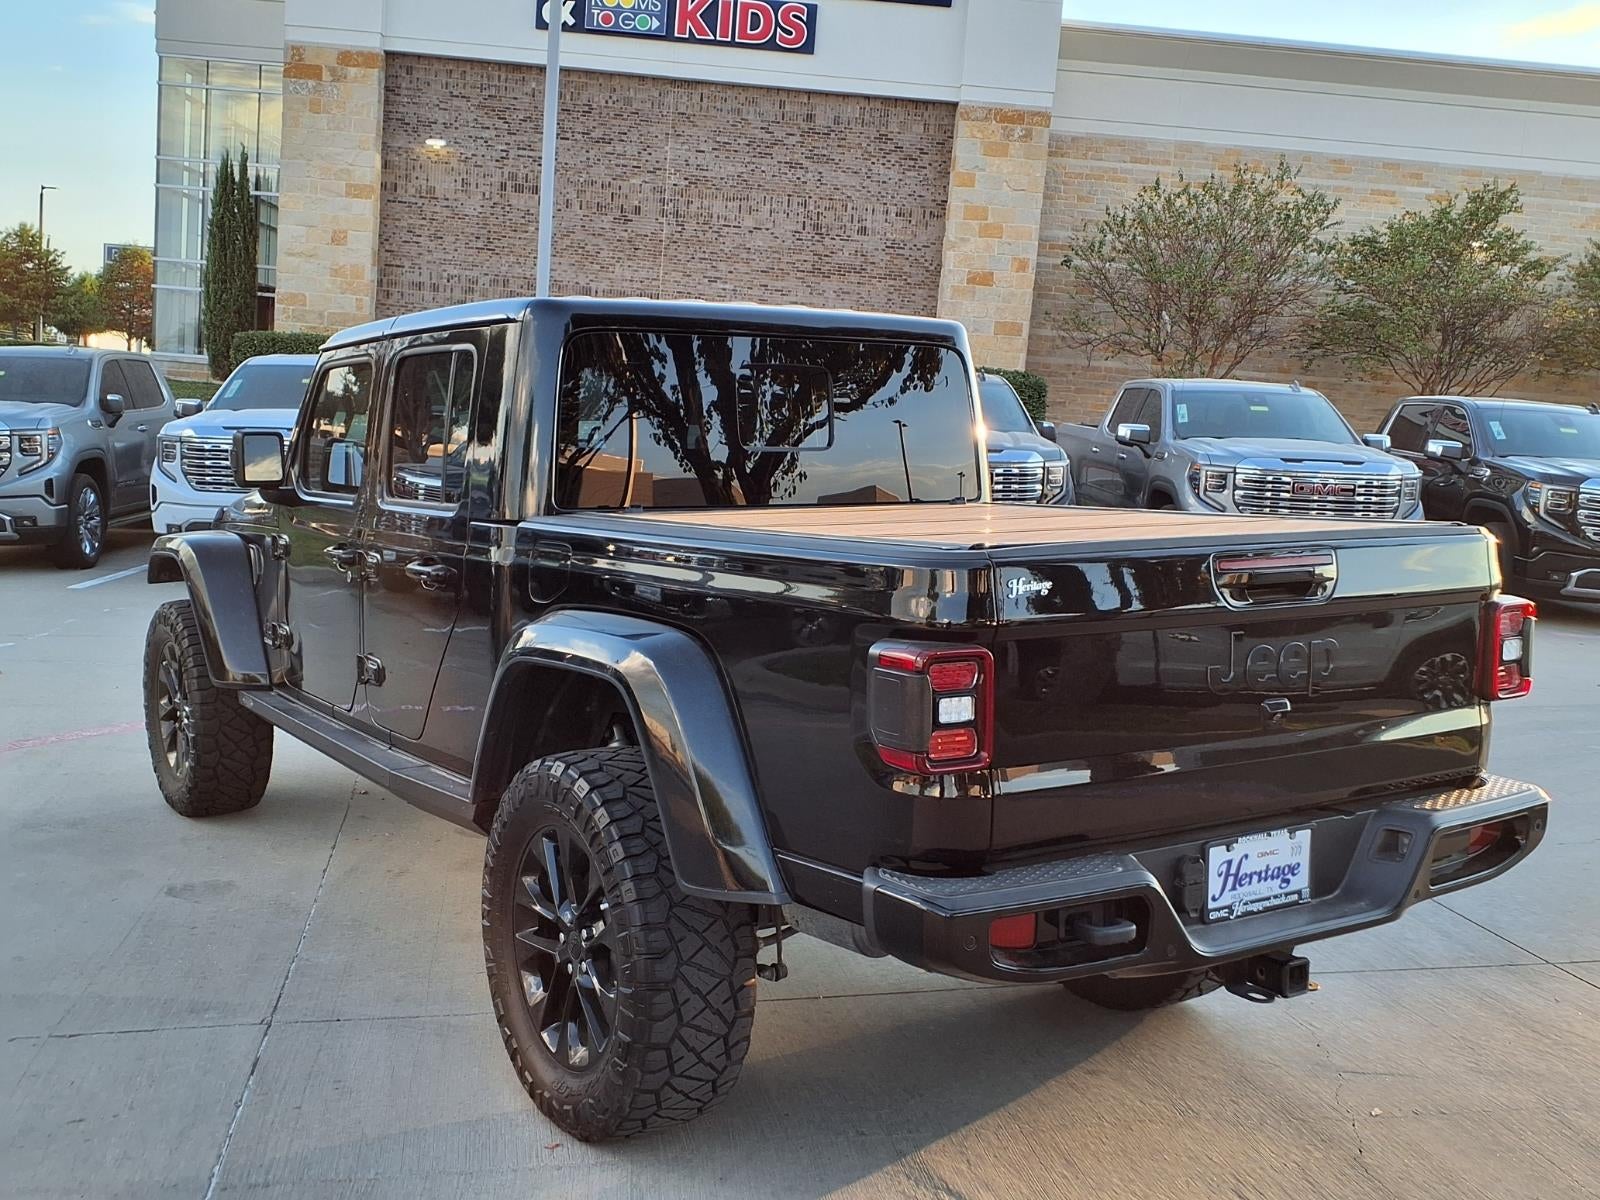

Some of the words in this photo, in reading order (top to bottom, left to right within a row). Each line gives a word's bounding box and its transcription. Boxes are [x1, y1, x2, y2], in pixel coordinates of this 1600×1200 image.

[591, 10, 615, 28] TO
[619, 12, 651, 31] GO
[674, 0, 808, 48] KIDS
[1294, 483, 1355, 497] GMC
[1007, 576, 1053, 599] Heritage
[1207, 630, 1339, 697] Jeep
[1256, 848, 1280, 859] GMC
[1210, 853, 1301, 902] Heritage
[1208, 908, 1229, 920] GMC
